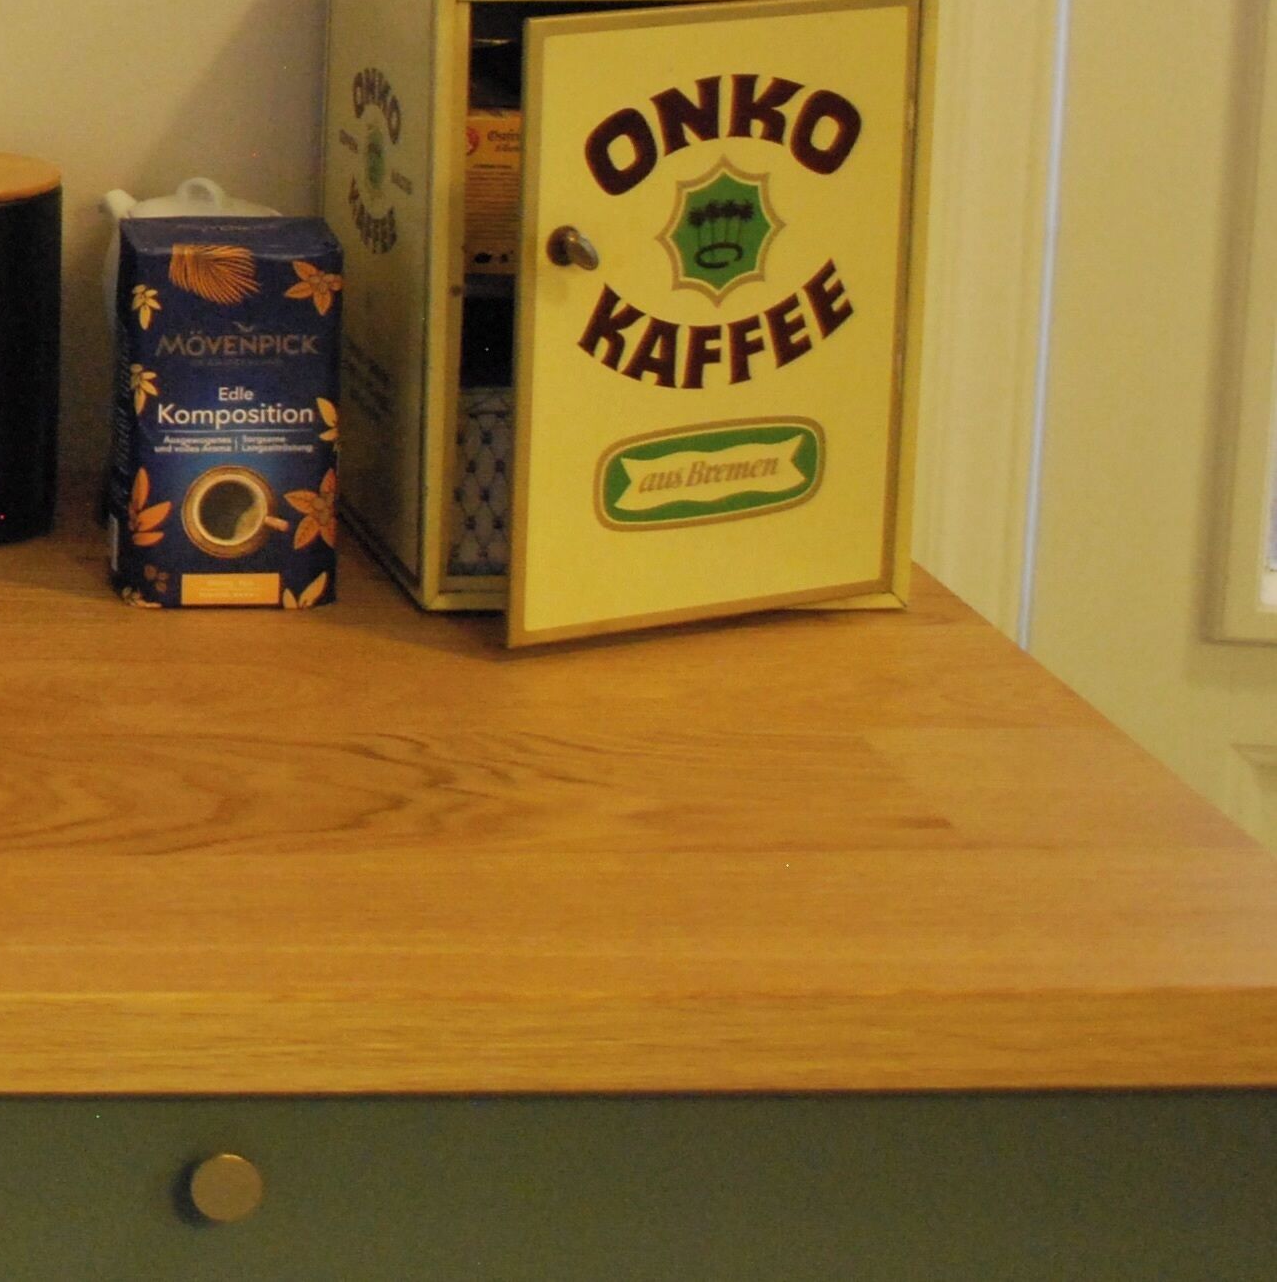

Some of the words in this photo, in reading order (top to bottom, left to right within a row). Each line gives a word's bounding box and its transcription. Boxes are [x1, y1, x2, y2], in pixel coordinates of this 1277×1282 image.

[353, 68, 401, 145] ONKO
[584, 74, 862, 196] ONKO
[577, 257, 854, 389] KAFFEE
[155, 329, 319, 357] MÖVENPICK
[218, 386, 254, 401] Edle
[157, 403, 313, 430] Komposition
[639, 469, 683, 493] aus
[685, 458, 779, 487] Bremen
